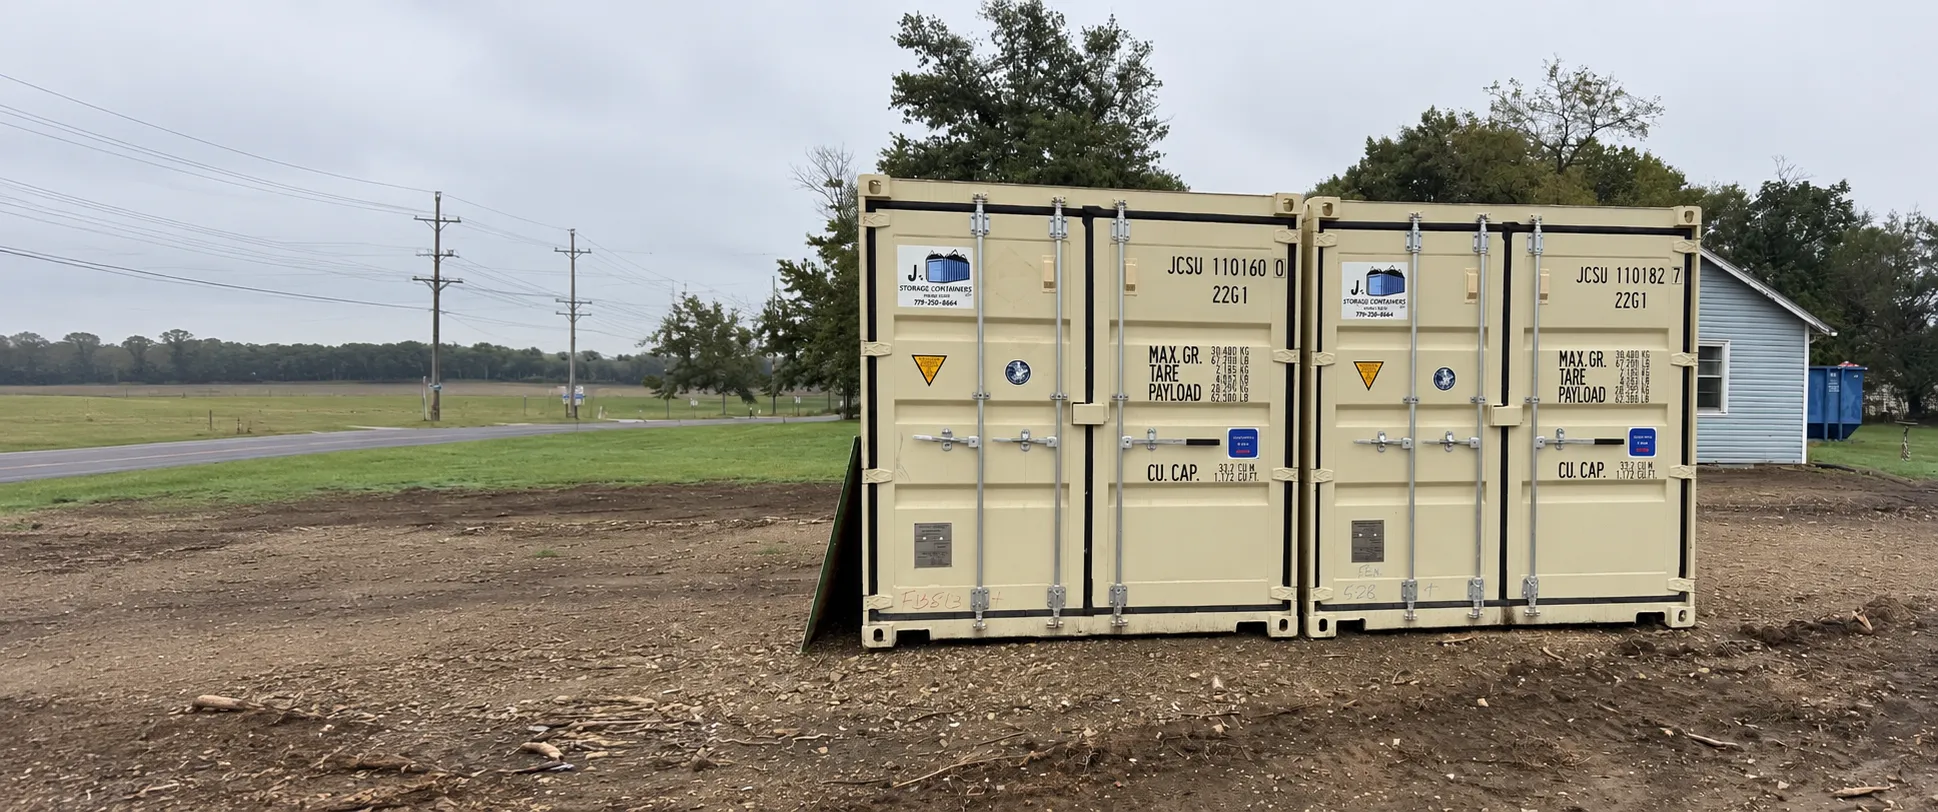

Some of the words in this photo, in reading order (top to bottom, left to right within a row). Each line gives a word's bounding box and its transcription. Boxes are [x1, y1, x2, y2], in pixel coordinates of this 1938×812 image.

[1167, 256, 1203, 275] JCSU
[1213, 257, 1266, 277] 110160
[1275, 259, 1284, 277] 0
[1576, 266, 1608, 284] JCSU
[1616, 266, 1665, 284] 110182
[1673, 267, 1681, 284] 7
[931, 285, 972, 293] CONTAINERS
[1212, 285, 1247, 304] 22G1
[1615, 291, 1646, 309] 22G1
[1149, 345, 1180, 364] MAX.
[1183, 346, 1203, 364] GR.
[1240, 346, 1250, 356] KG
[1559, 350, 1587, 368] MAX.
[1589, 350, 1607, 368] GR.
[1149, 364, 1180, 382] TARE
[1559, 368, 1586, 386] TARE
[1149, 383, 1202, 402] PAYLOAD
[1240, 393, 1249, 403] LB
[1558, 386, 1606, 403] PAYLOAD
[1148, 464, 1167, 482] CU.
[1172, 464, 1200, 482] CAP.
[1558, 461, 1576, 478] CU.
[1580, 461, 1606, 478] CAP.
